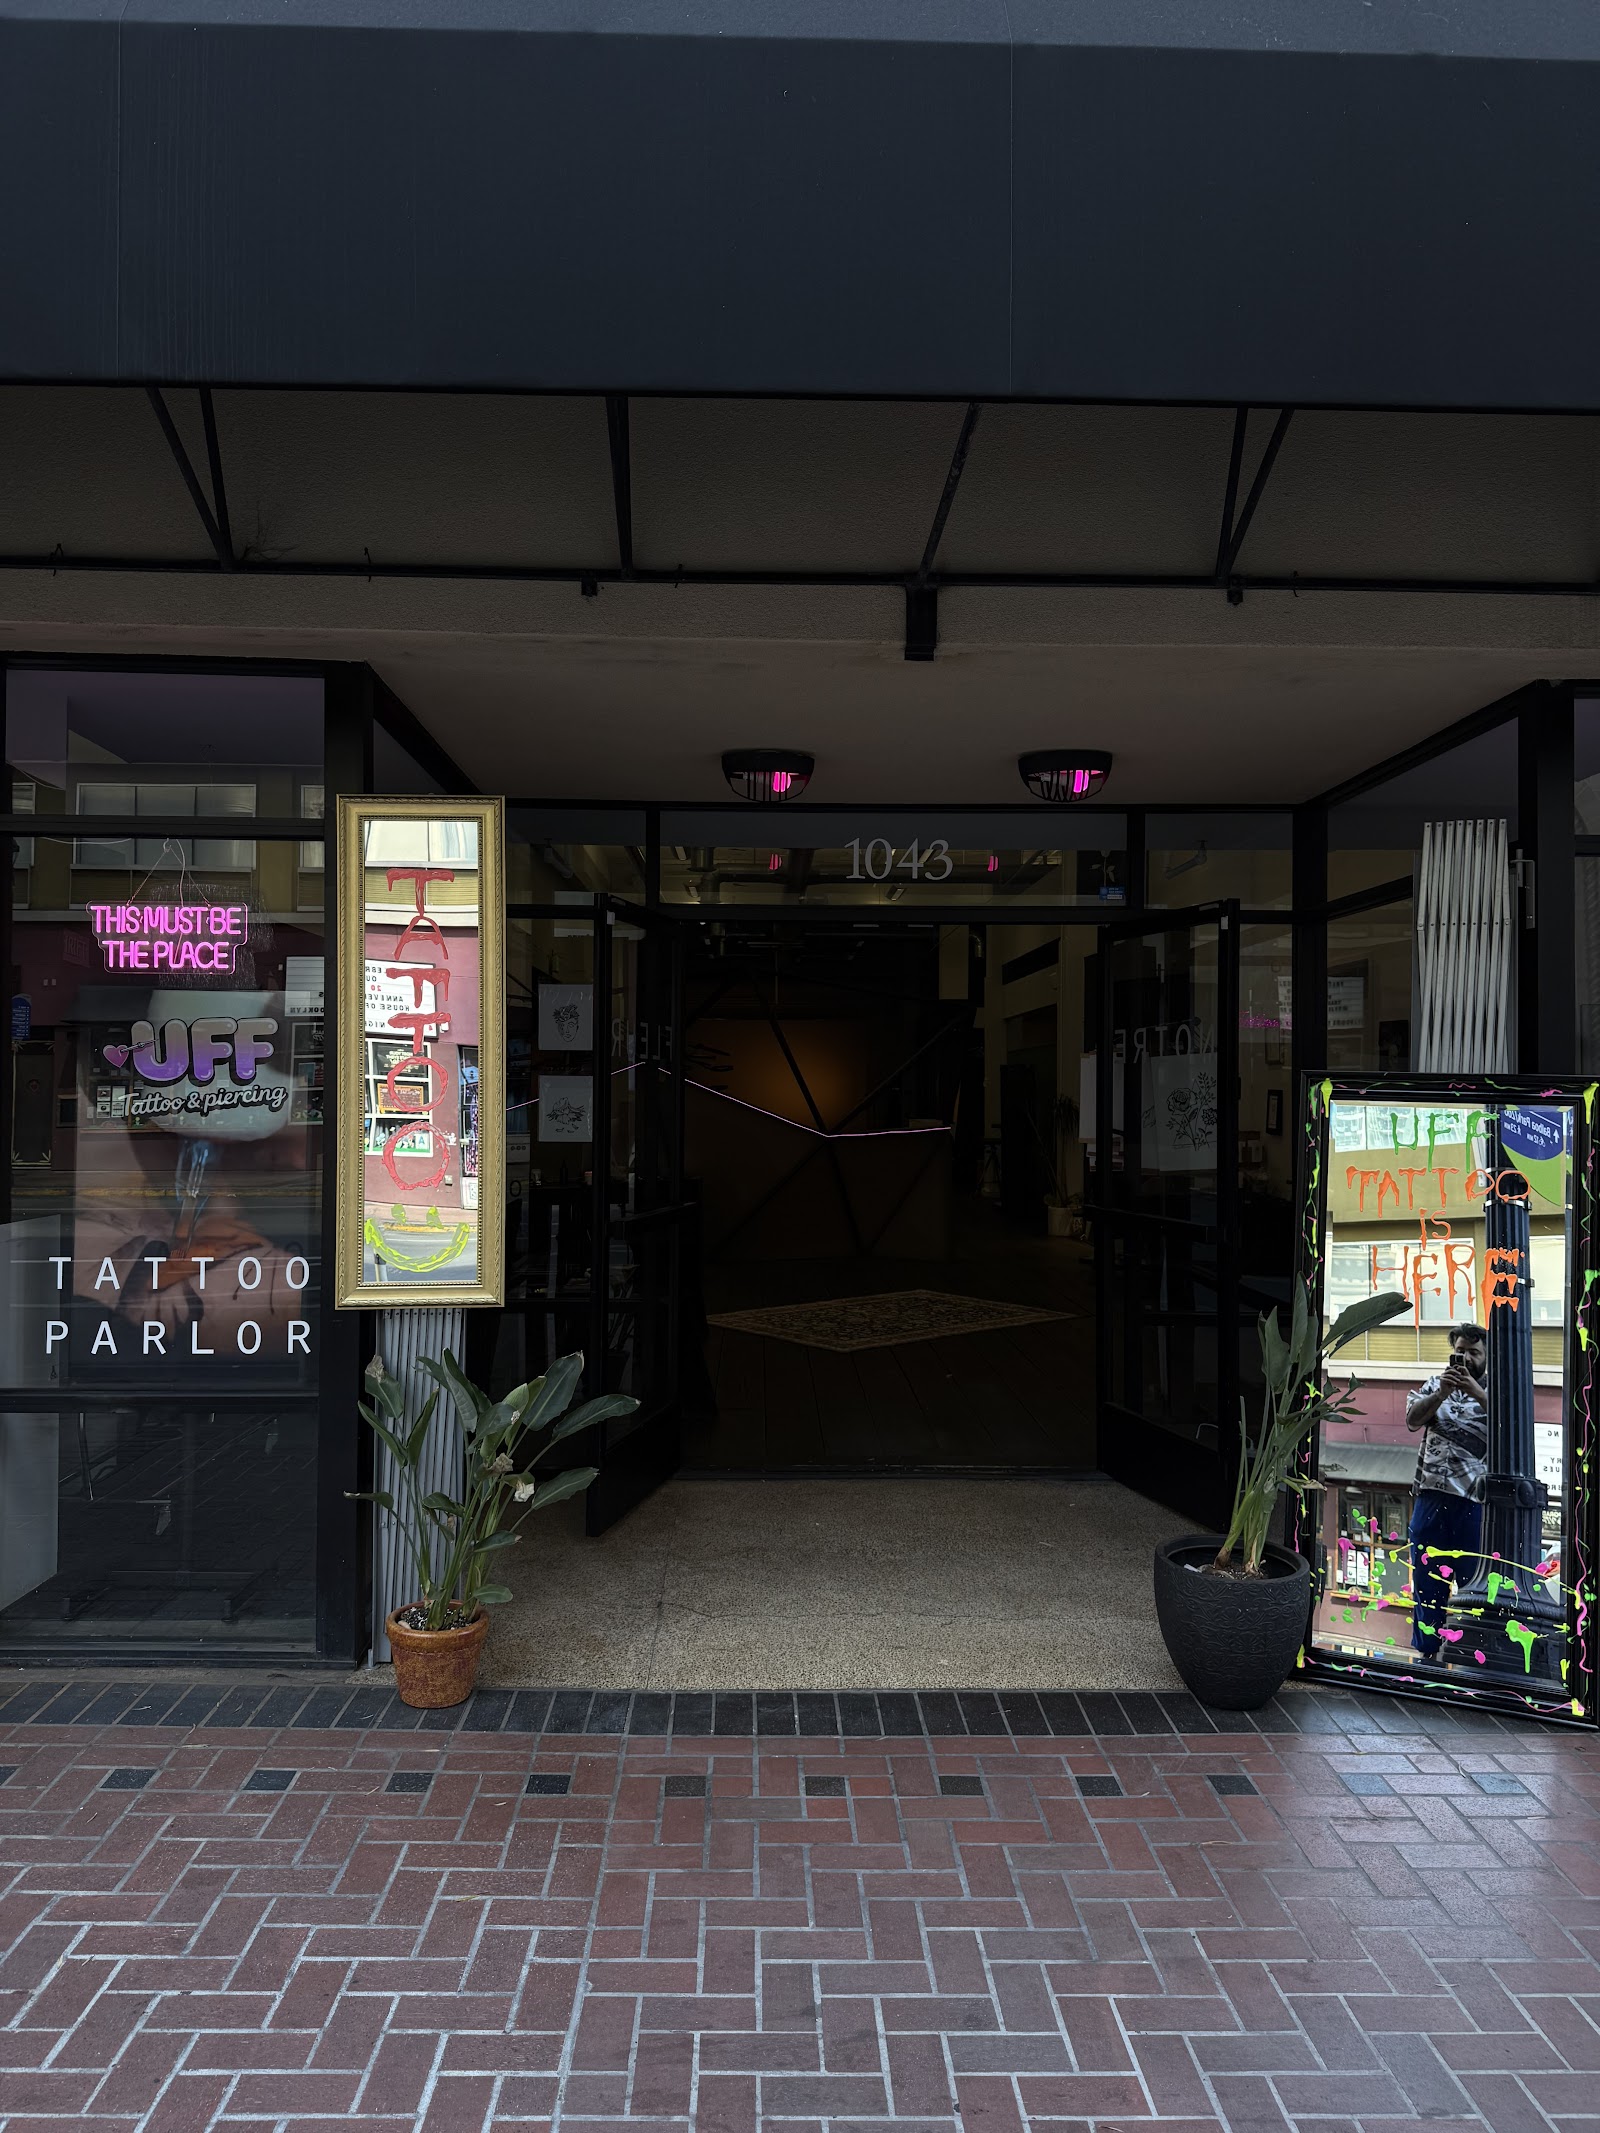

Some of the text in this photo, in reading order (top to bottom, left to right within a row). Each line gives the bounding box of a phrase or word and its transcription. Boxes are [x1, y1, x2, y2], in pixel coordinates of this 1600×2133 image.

[843, 837, 954, 882] 1043
[90, 905, 242, 935] THIS MUST BE
[101, 940, 151, 969] THE
[153, 940, 230, 969] PLACE
[131, 1017, 279, 1086] UFF
[381, 868, 456, 1191] TATTOO
[121, 1092, 186, 1117] Tattoo
[187, 1096, 202, 1112] &
[202, 1085, 288, 1116] piercing
[1391, 1110, 1500, 1173] UFF
[1344, 1165, 1531, 1219] TATTOO
[48, 1256, 311, 1290] TATTOO
[1371, 1244, 1525, 1331] HERE
[45, 1321, 312, 1355] PARLOR
